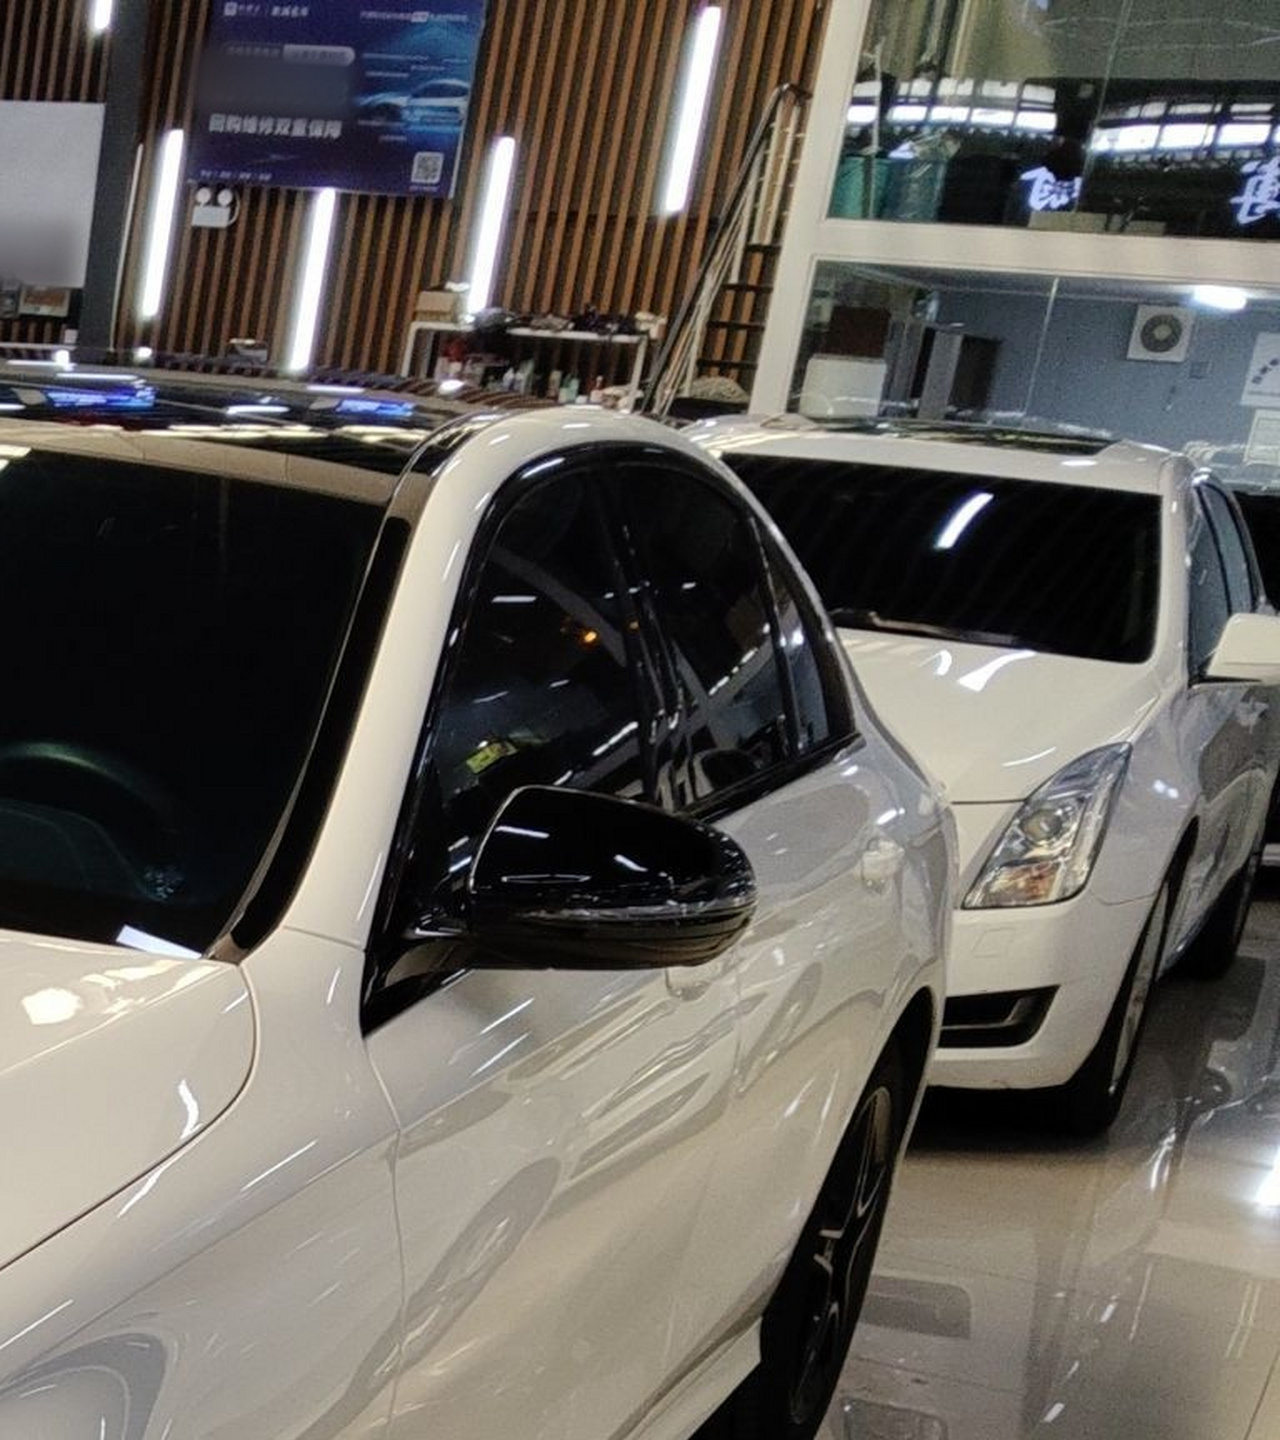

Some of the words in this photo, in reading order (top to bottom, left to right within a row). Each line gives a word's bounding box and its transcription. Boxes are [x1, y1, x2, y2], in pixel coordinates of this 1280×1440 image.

[208, 113, 343, 140] 回购维修双重保障
